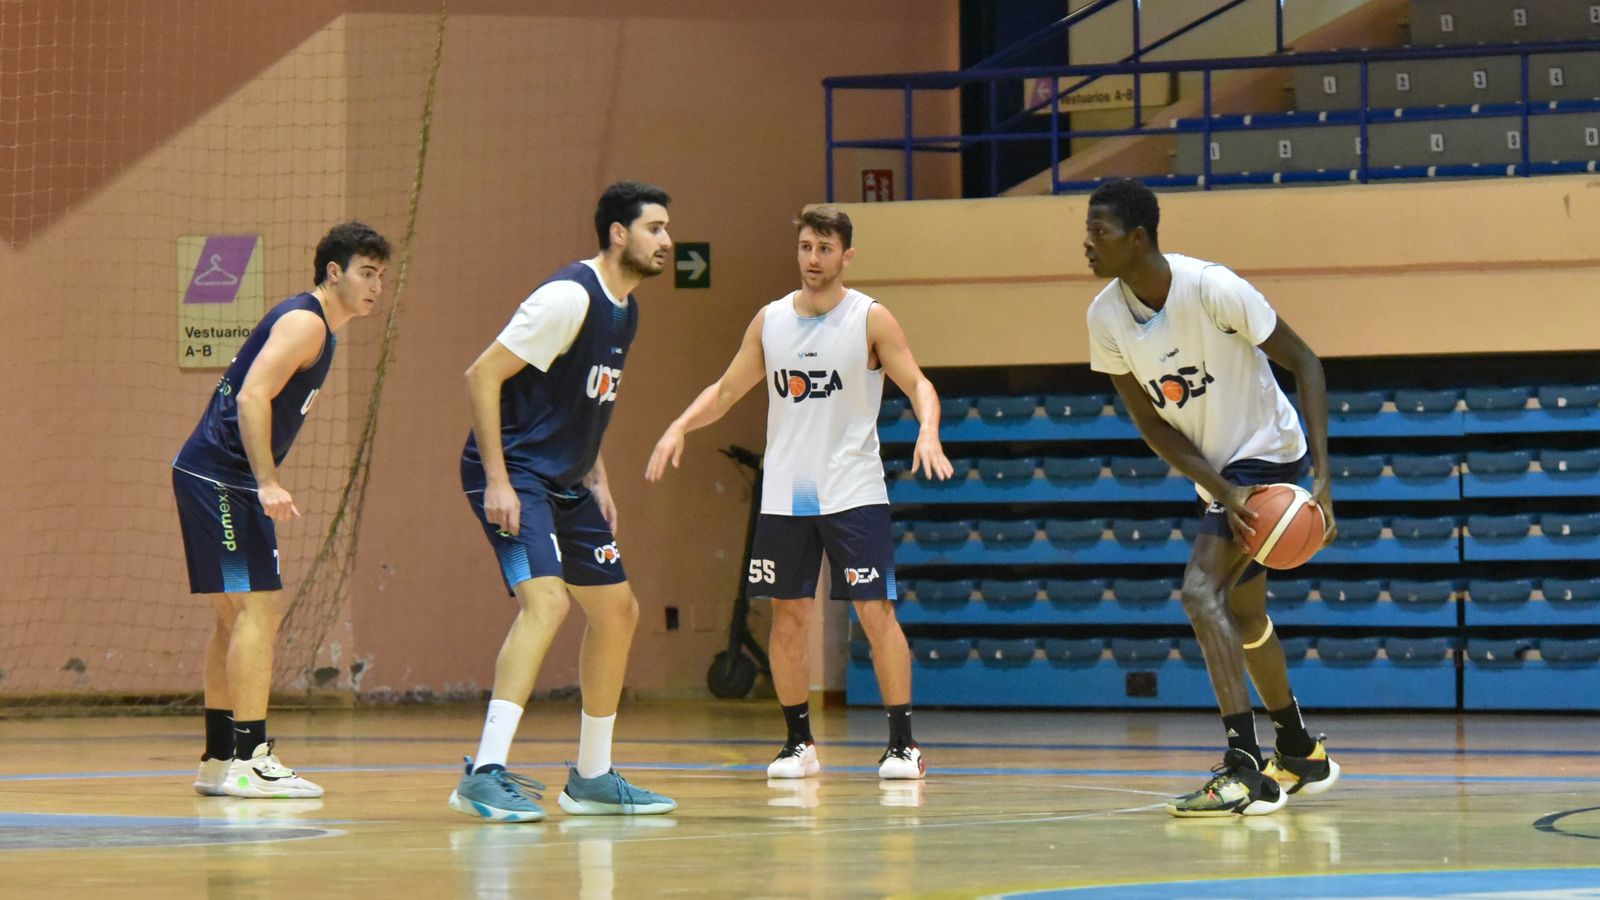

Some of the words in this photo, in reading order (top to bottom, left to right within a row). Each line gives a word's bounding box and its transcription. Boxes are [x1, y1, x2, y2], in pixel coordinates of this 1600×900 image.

[185, 345, 212, 357] A-B
[774, 368, 843, 403] UDEA
[748, 558, 776, 584] 55
